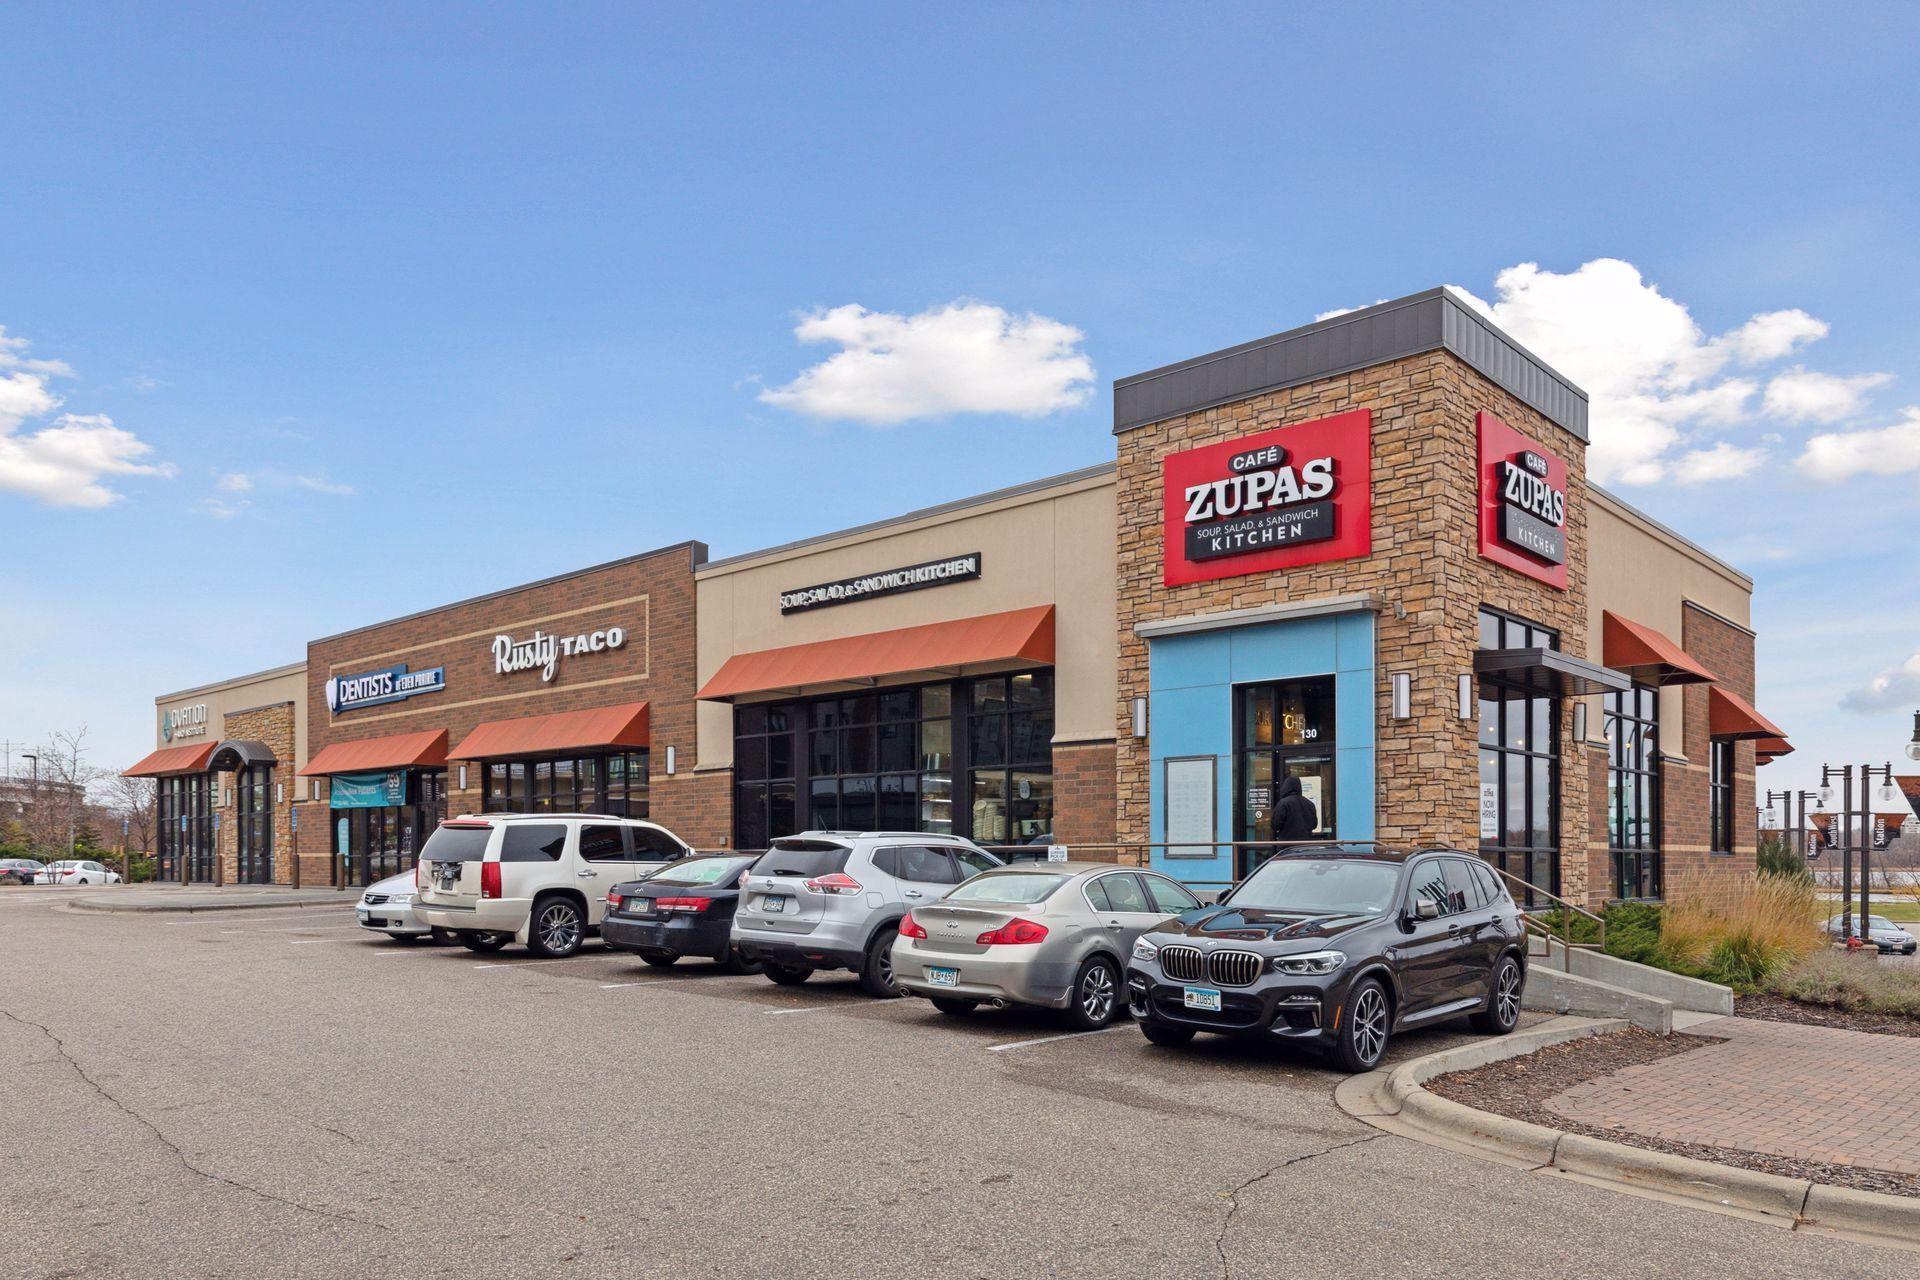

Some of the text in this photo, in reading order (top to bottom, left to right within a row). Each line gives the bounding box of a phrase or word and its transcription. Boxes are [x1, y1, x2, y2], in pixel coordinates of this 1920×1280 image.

[1233, 446, 1278, 470] CAFÉ
[1526, 453, 1547, 475] CAFÉ
[1184, 456, 1335, 523] ZUPAS
[1505, 460, 1564, 528] ZUPAS
[1258, 520, 1264, 528] &
[1266, 508, 1319, 526] SANDWICH
[1212, 523, 1302, 552] KITCHEN
[1518, 526, 1555, 555] KITCHEN
[853, 570, 916, 594] SANDWICH
[915, 557, 976, 583] KITCHEN
[492, 627, 623, 682] Rusty TACO
[340, 672, 393, 702] DENTISTS
[171, 703, 206, 728] OVATION
[1300, 728, 1318, 739] 130
[1807, 833, 1817, 857] Station
[1827, 815, 1838, 848] SouthWest
[1874, 818, 1885, 846] Station
